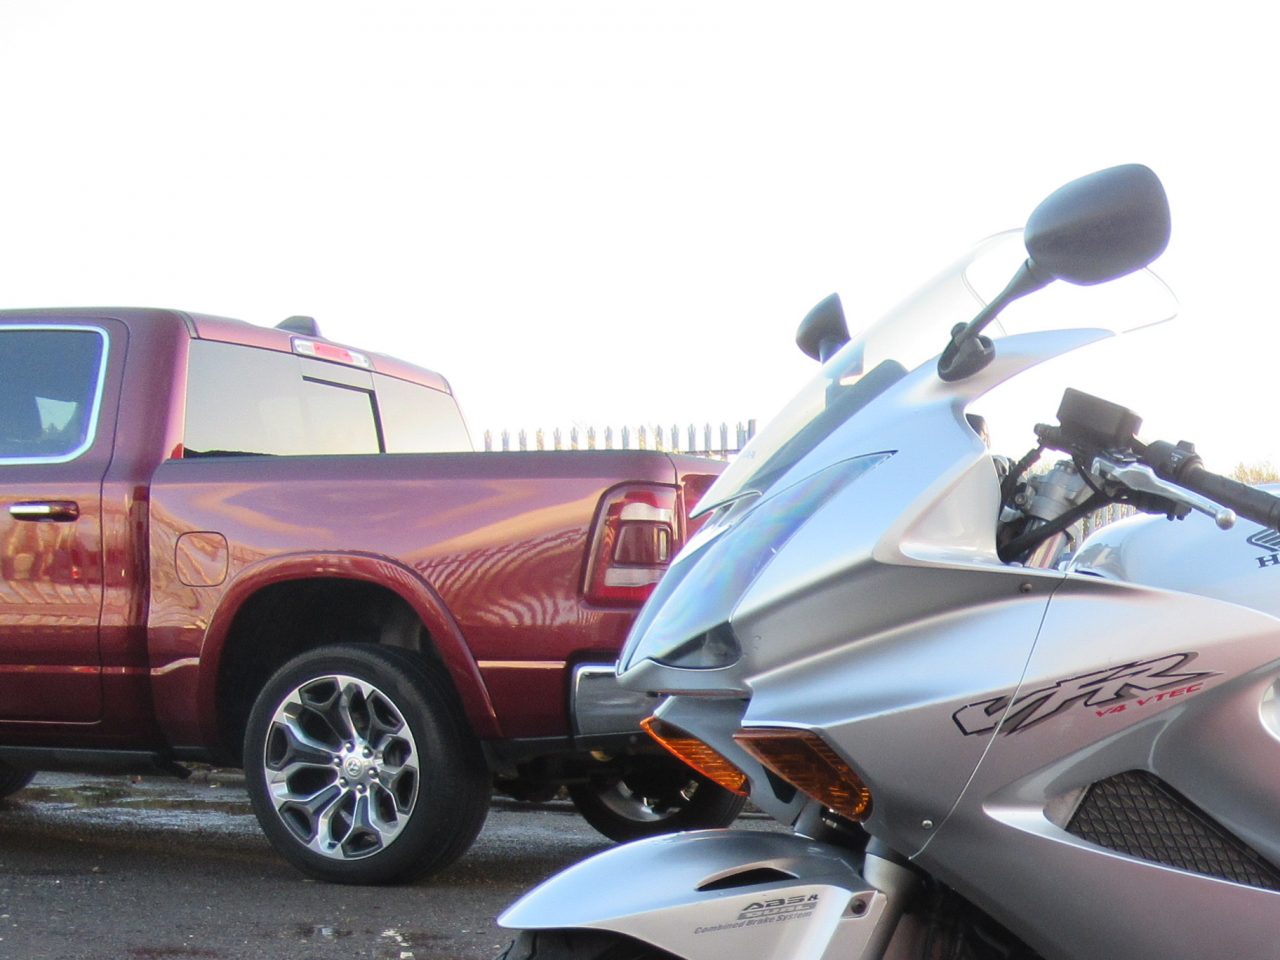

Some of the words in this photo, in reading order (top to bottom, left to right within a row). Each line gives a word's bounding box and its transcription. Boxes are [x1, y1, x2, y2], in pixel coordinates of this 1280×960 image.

[952, 651, 1224, 737] VFR
[1096, 703, 1127, 718] V4
[1136, 682, 1205, 707] VTEC
[742, 895, 807, 911] ABS
[694, 920, 746, 935] Combined
[745, 916, 776, 927] Brake
[775, 911, 813, 922] System
